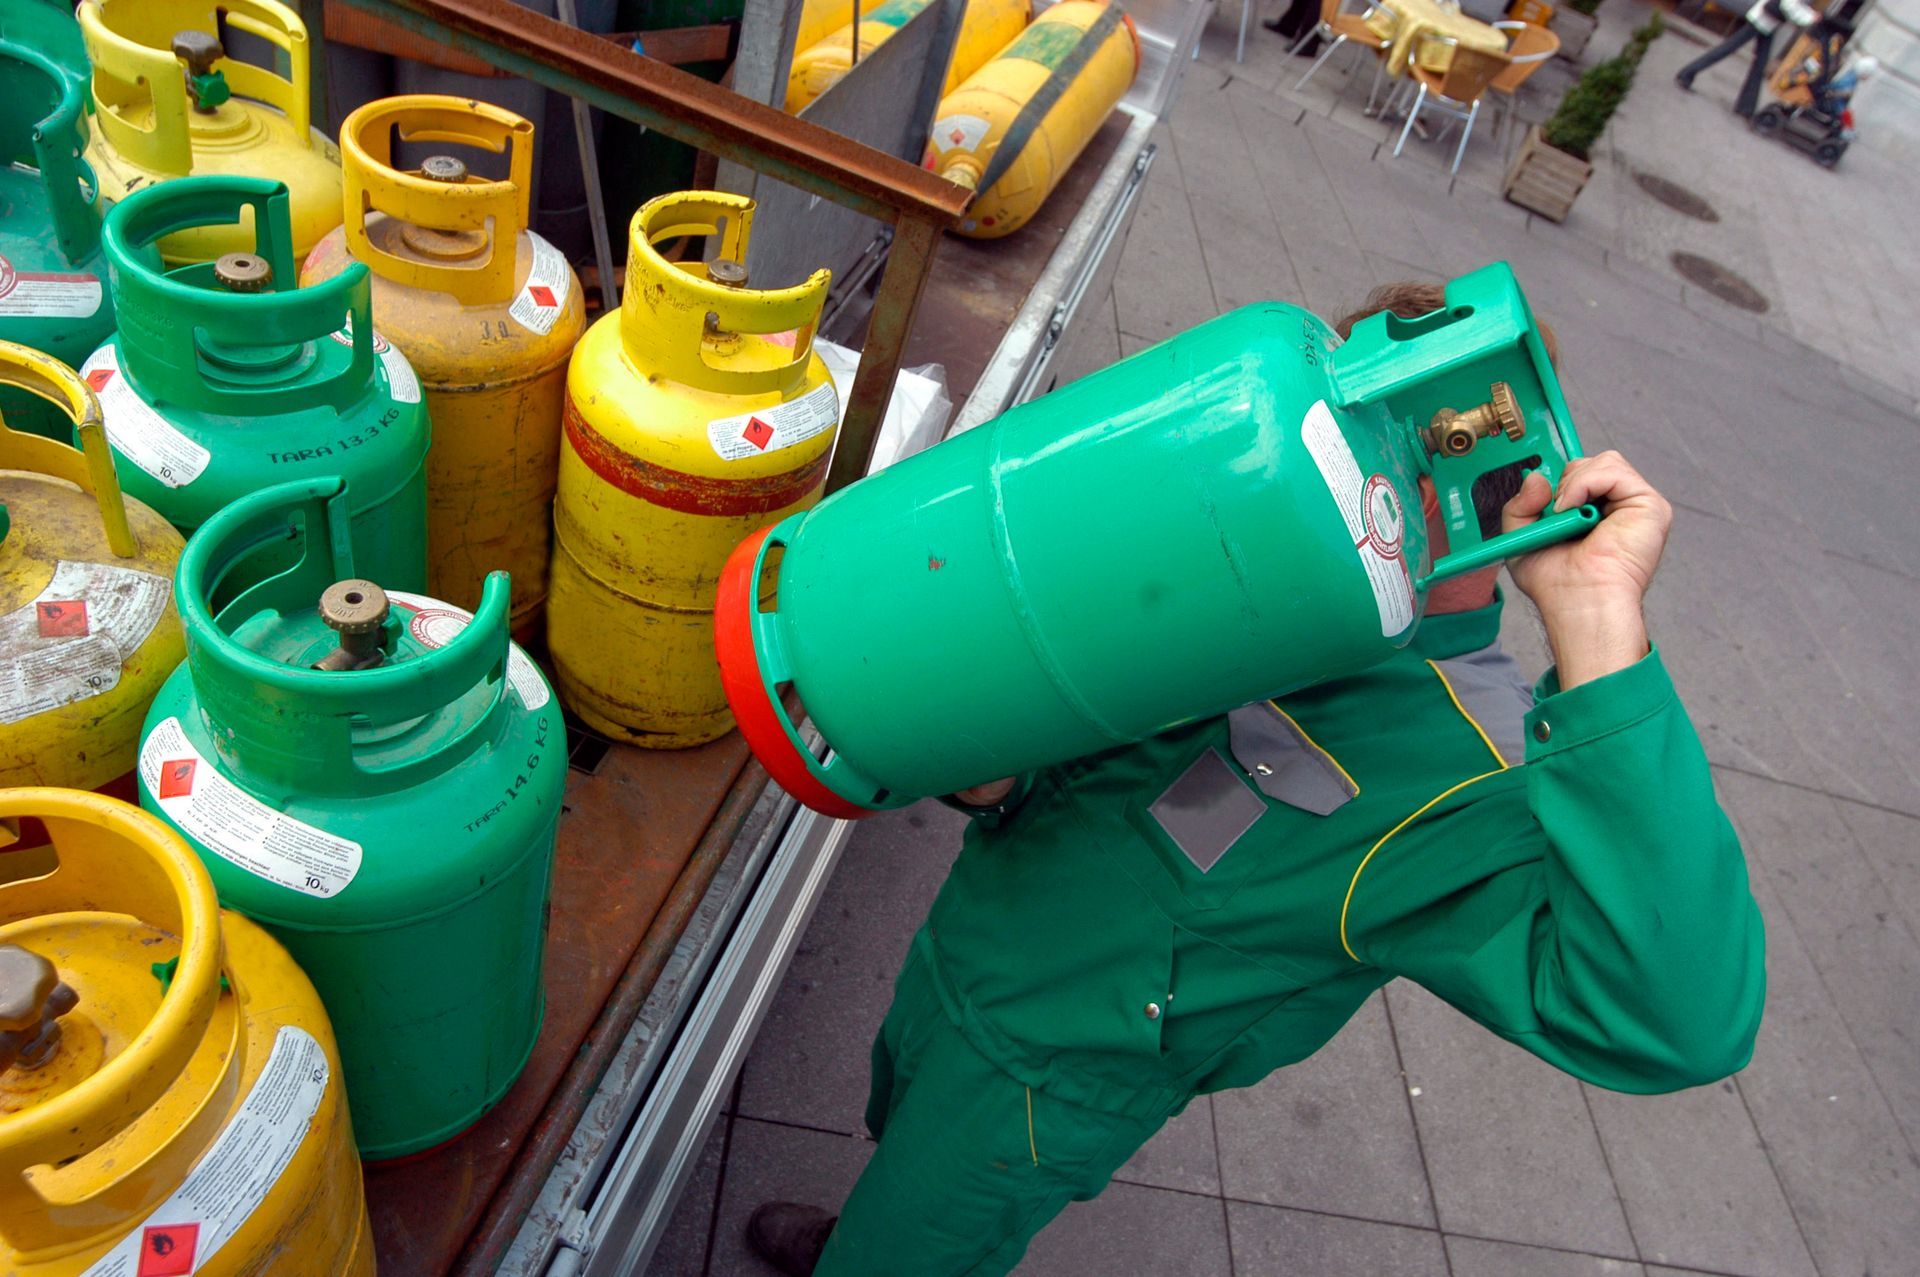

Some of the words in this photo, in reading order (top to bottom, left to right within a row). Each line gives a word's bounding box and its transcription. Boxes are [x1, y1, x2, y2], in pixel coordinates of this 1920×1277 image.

[266, 446, 333, 464] TARA
[337, 426, 380, 451] 13.3
[379, 408, 400, 428] KG
[159, 466, 172, 479] 10
[86, 675, 102, 689] 10
[463, 800, 508, 832] TARA
[505, 753, 540, 800] 14.6
[535, 717, 548, 748] KG
[304, 876, 320, 890] 10
[319, 883, 330, 894] kg
[312, 1069, 324, 1085] 10
